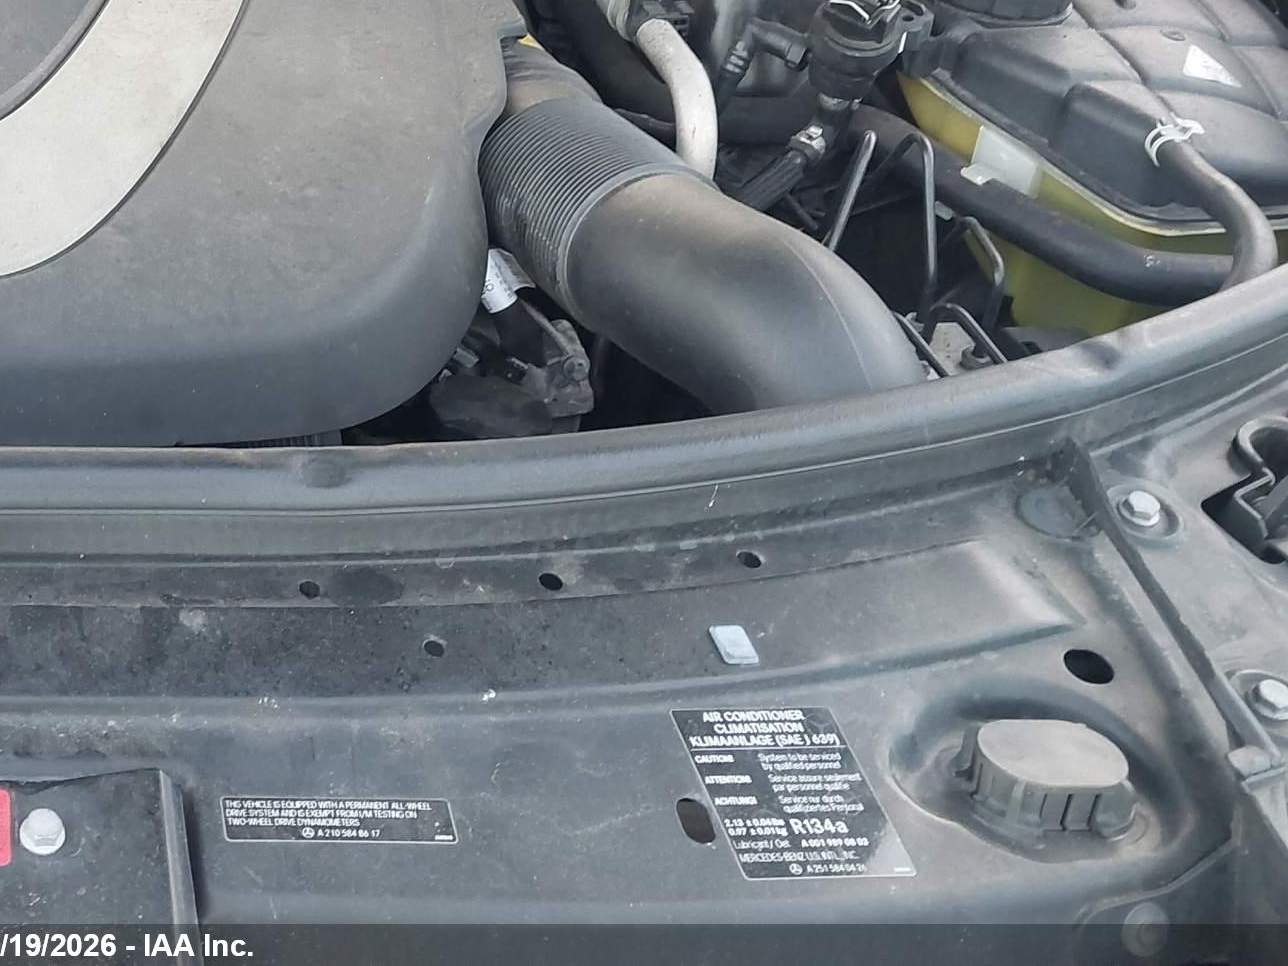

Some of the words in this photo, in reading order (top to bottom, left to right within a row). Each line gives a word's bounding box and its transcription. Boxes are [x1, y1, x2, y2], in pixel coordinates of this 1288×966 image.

[702, 712, 723, 722] AIR
[724, 710, 805, 722] CONDITIONER
[714, 722, 804, 734] CLIMATISATION
[689, 735, 774, 747] KLIMAANLAGE
[775, 734, 804, 747] (SAE
[812, 733, 840, 746] 639)
[758, 753, 787, 764] System
[225, 800, 242, 809] THIS
[242, 800, 272, 809] VEHICLE
[273, 800, 281, 809] IS
[282, 800, 317, 809] EQUIPPED
[318, 801, 338, 809] WITH
[338, 801, 345, 809] A
[345, 801, 389, 810] PERMANENT
[392, 801, 432, 810] ALL-WHEEL
[226, 808, 249, 817] DRIVE
[249, 808, 279, 817] SYSTEM
[280, 809, 297, 817] AND
[297, 809, 305, 817] IS
[306, 809, 335, 817] EXEMPT
[335, 809, 359, 818] FROM
[374, 810, 405, 819] TESTING
[405, 810, 418, 819] ON
[228, 817, 274, 826] TWO-WHEEL
[274, 818, 297, 826] DRIVE
[297, 817, 361, 826] DYNAMOMETERS
[789, 817, 849, 835] R134a
[317, 829, 325, 837] A
[325, 829, 341, 837] 210
[739, 851, 806, 863] MERCEDES-BENZ
